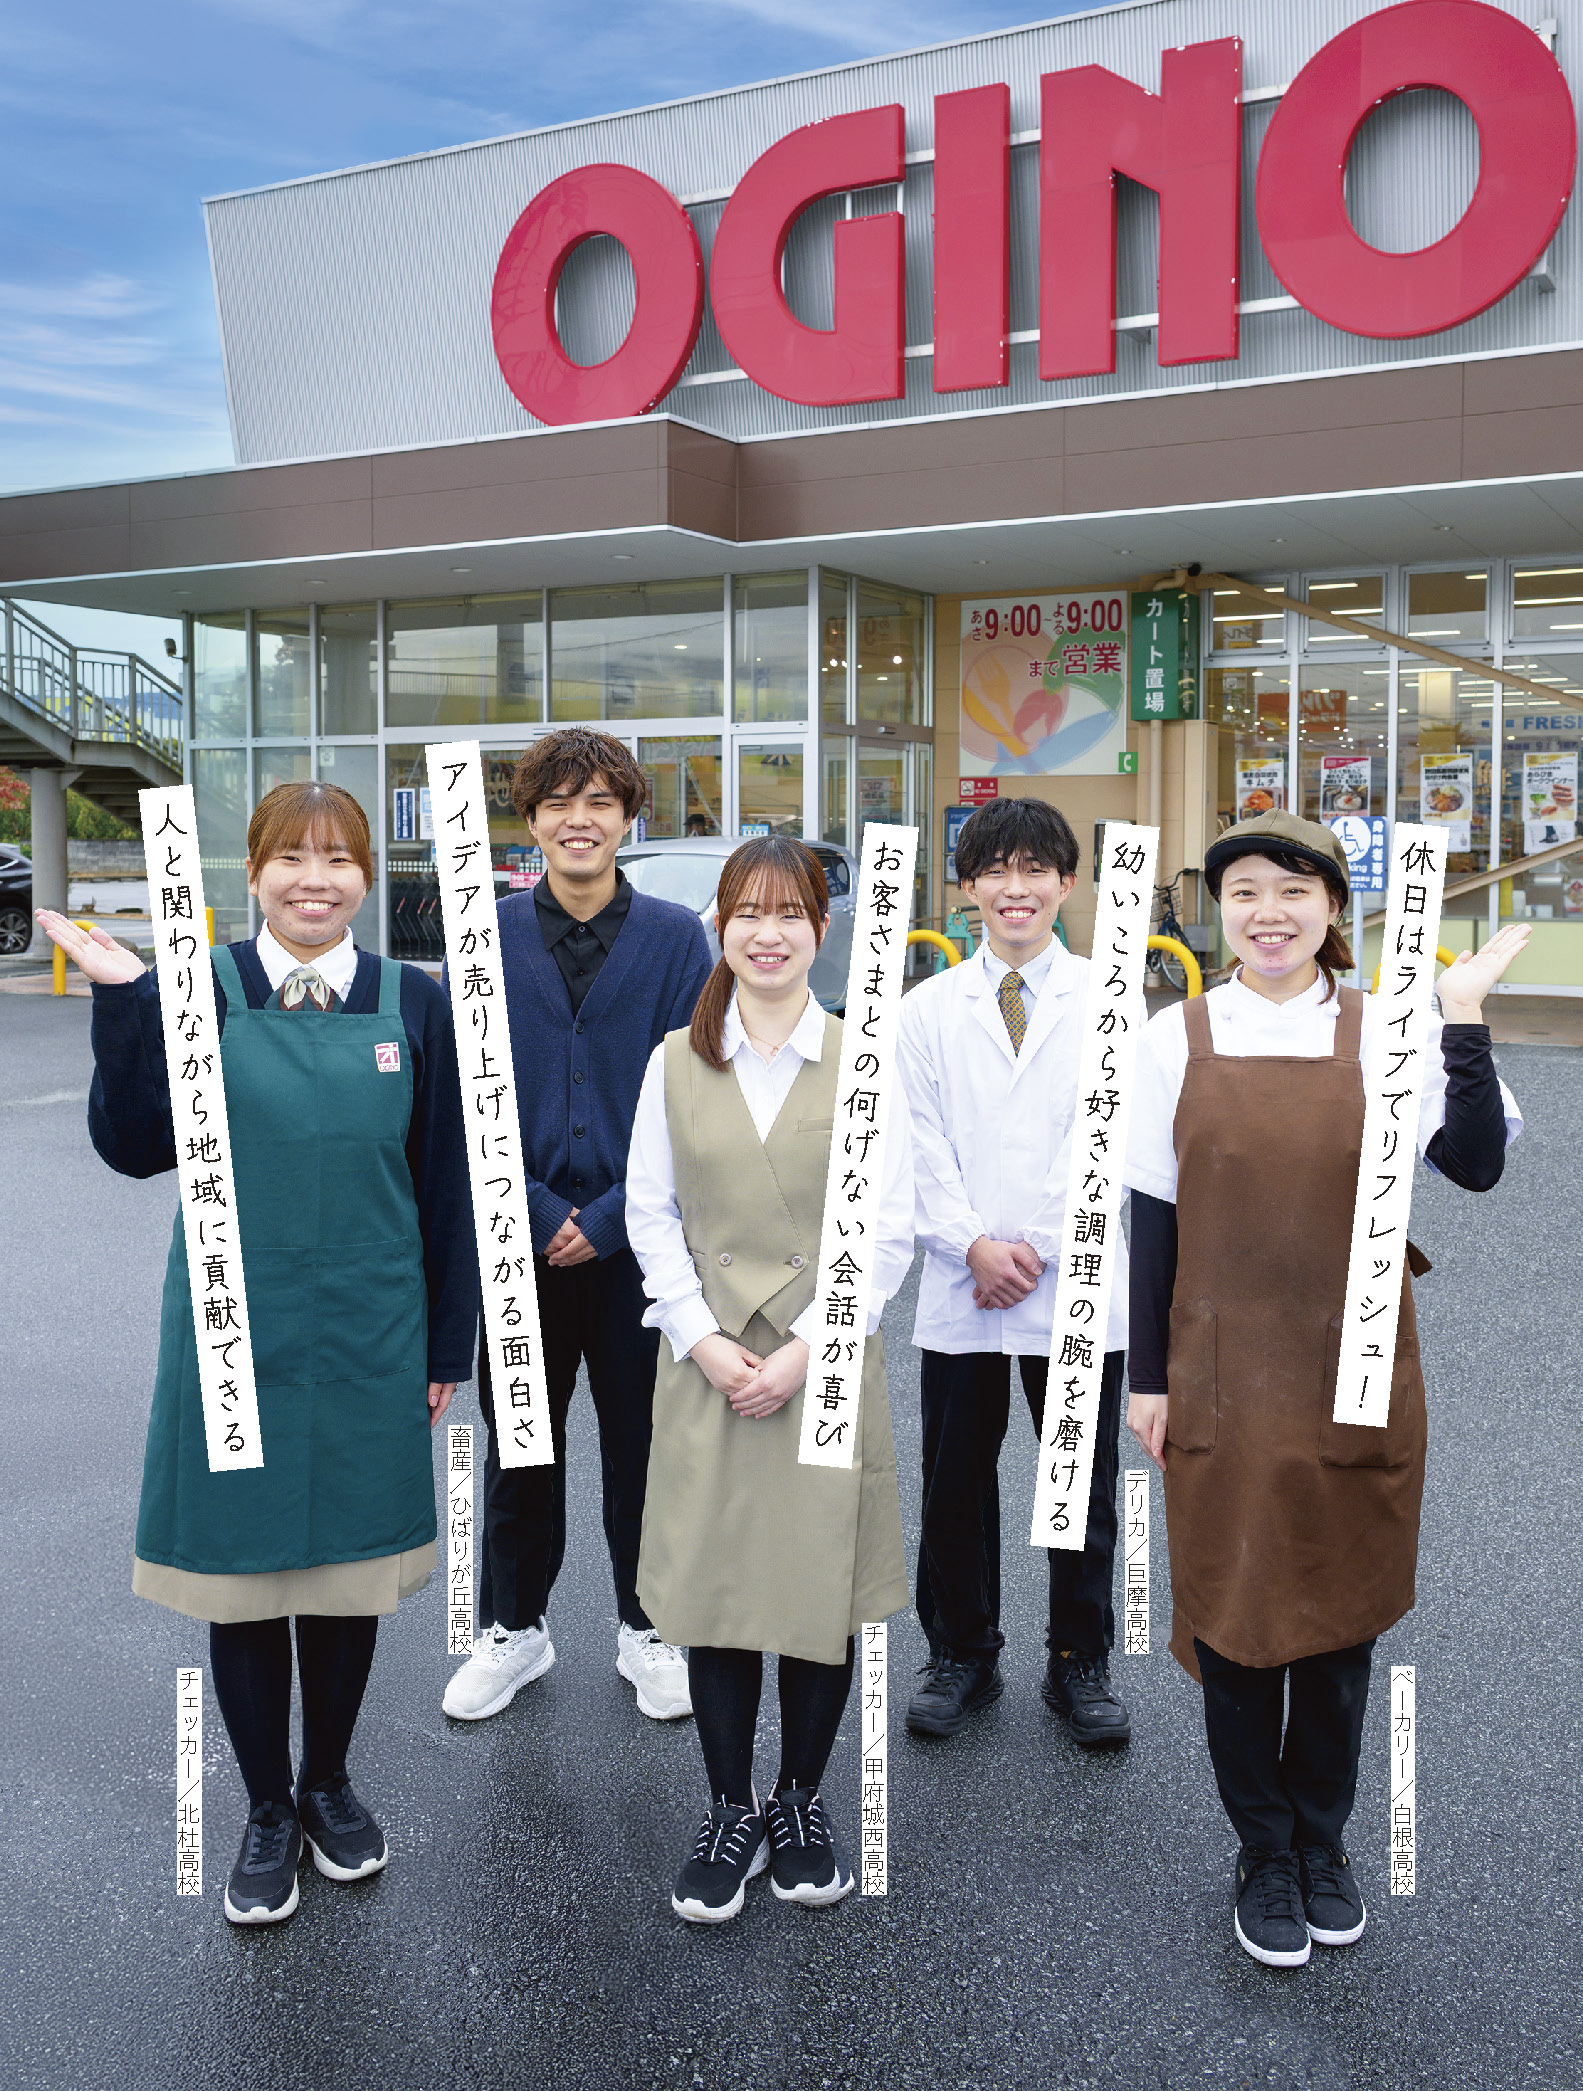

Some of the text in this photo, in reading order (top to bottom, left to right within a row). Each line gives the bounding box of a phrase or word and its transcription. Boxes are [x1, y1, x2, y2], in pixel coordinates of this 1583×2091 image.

[491, 0, 1577, 427] OGINO
[1028, 642, 1122, 677] まで営業
[1144, 598, 1165, 712] カート置場
